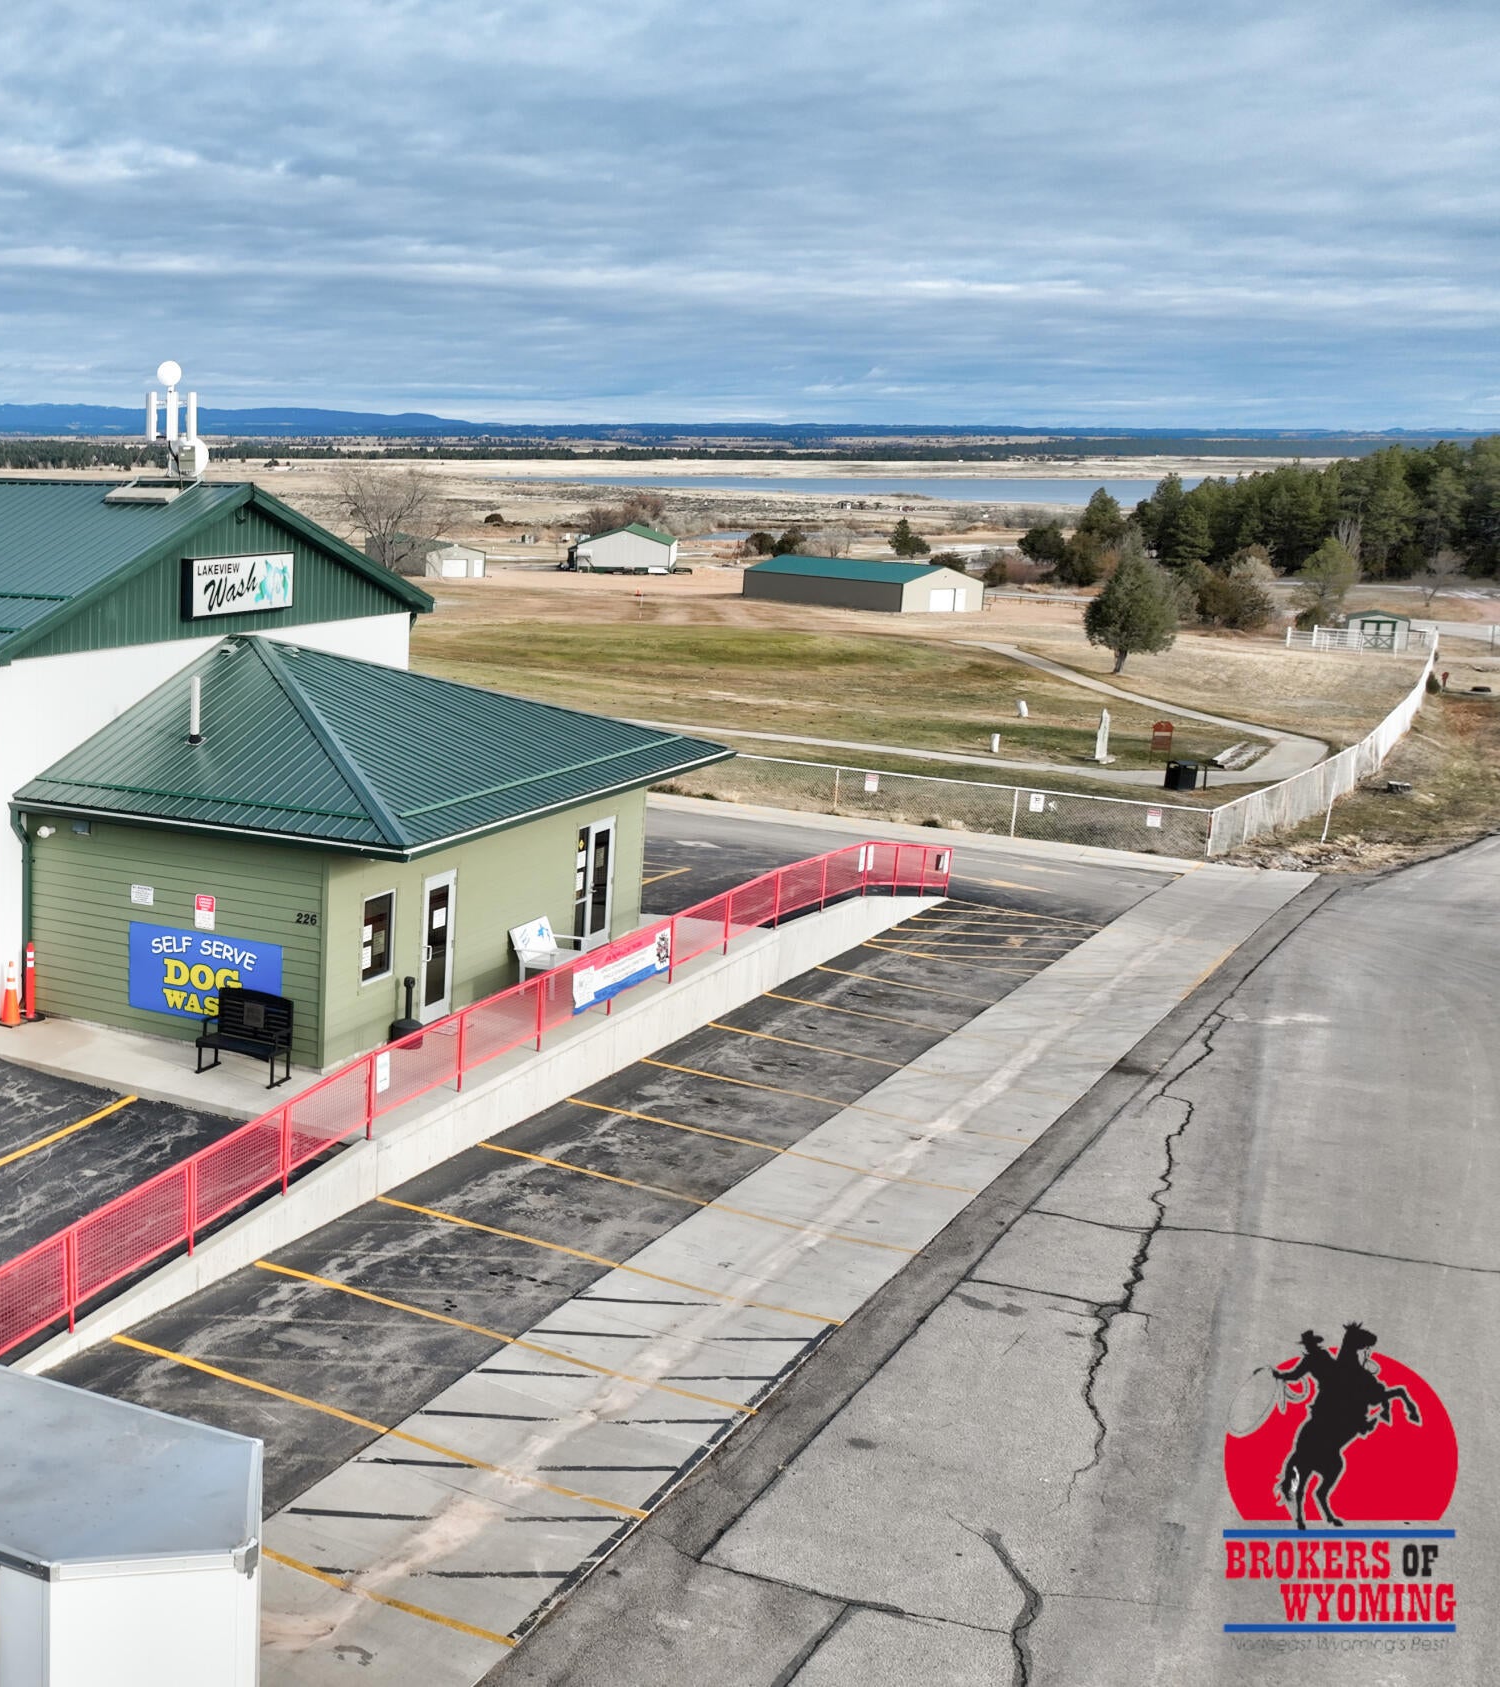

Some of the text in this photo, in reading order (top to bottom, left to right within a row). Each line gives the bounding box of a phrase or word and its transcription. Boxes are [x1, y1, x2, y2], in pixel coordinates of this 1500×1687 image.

[197, 563, 241, 576] LAKEVIEW
[203, 561, 257, 612] Wash
[295, 912, 318, 926] 226
[151, 936, 257, 971] SELF SERVE
[163, 957, 243, 991] DOG
[162, 988, 220, 1017] WAS
